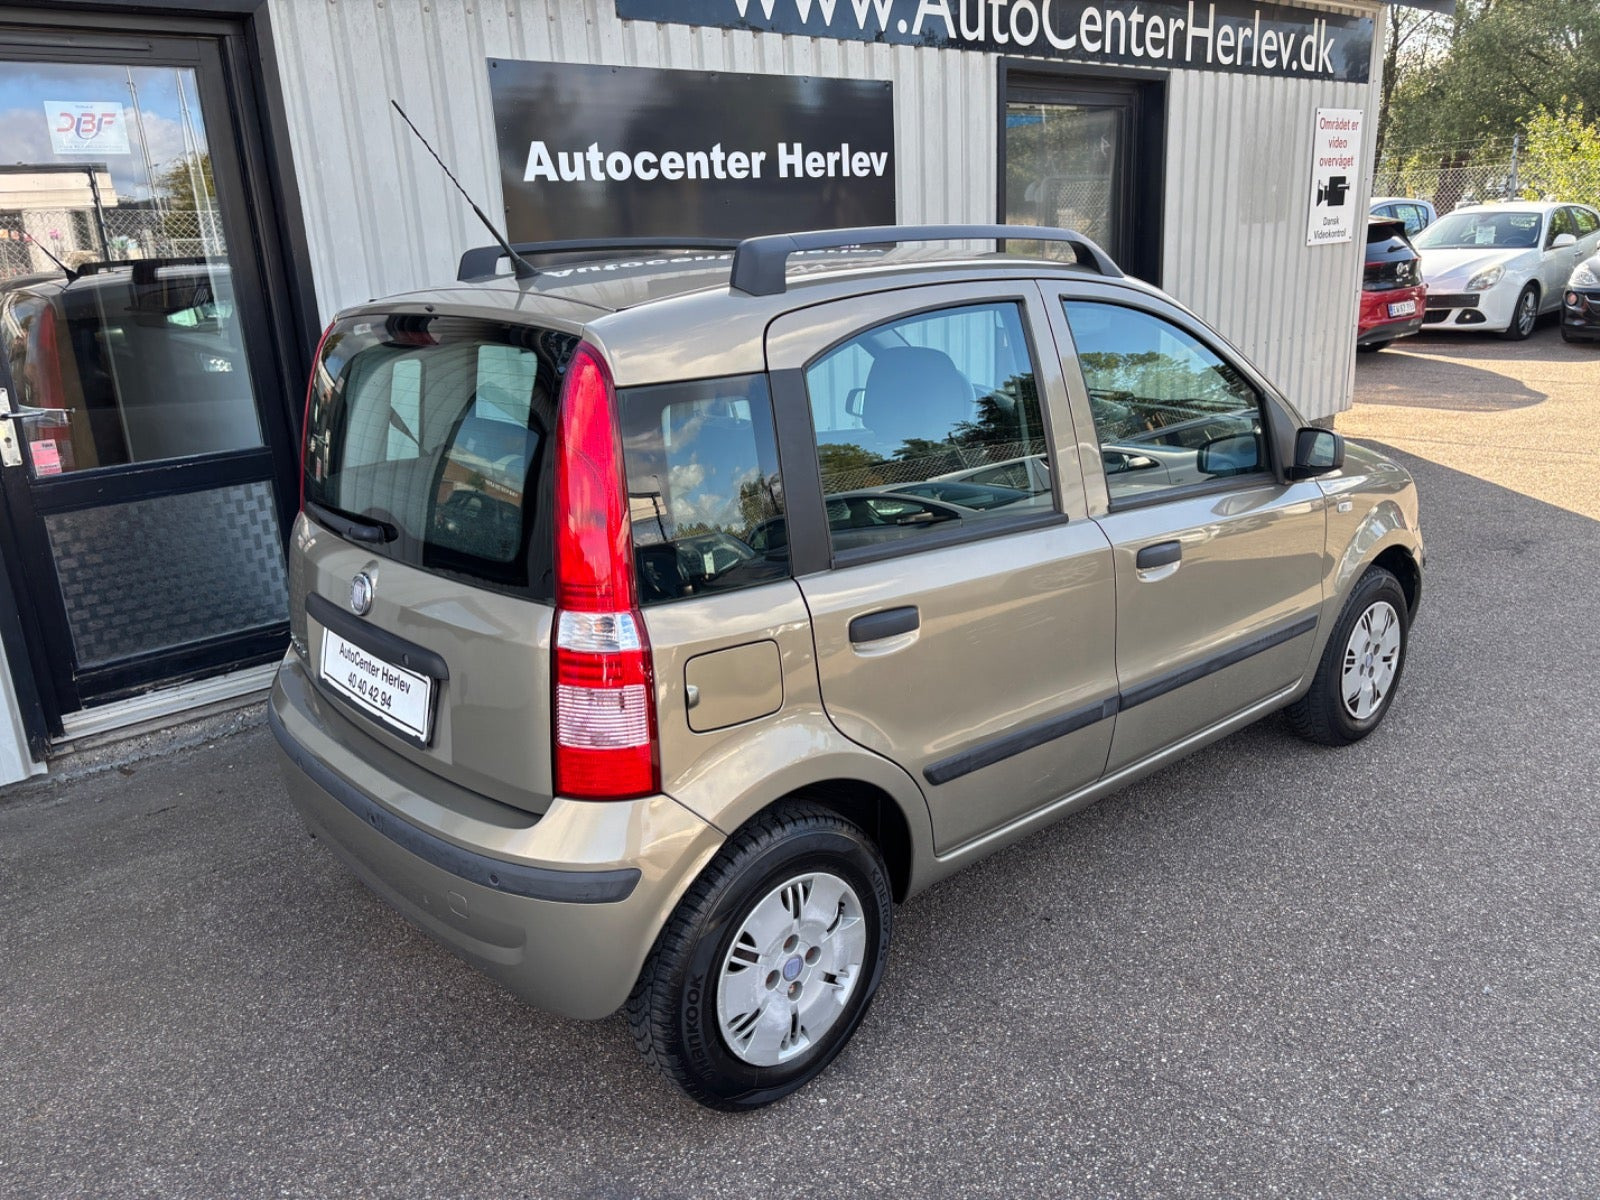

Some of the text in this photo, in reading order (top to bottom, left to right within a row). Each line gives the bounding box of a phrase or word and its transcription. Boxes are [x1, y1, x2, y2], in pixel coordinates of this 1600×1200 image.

[1320, 117, 1359, 131] Området er
[1328, 136, 1348, 149] video
[523, 141, 888, 182] Autocenter Herlev
[1319, 154, 1353, 169] overvåget
[1322, 216, 1339, 226] Dansk
[1313, 228, 1346, 239] Videokontrol
[339, 642, 380, 678] AutoCenter
[381, 666, 411, 694] Herlev
[348, 672, 391, 709] 40 40 42 94
